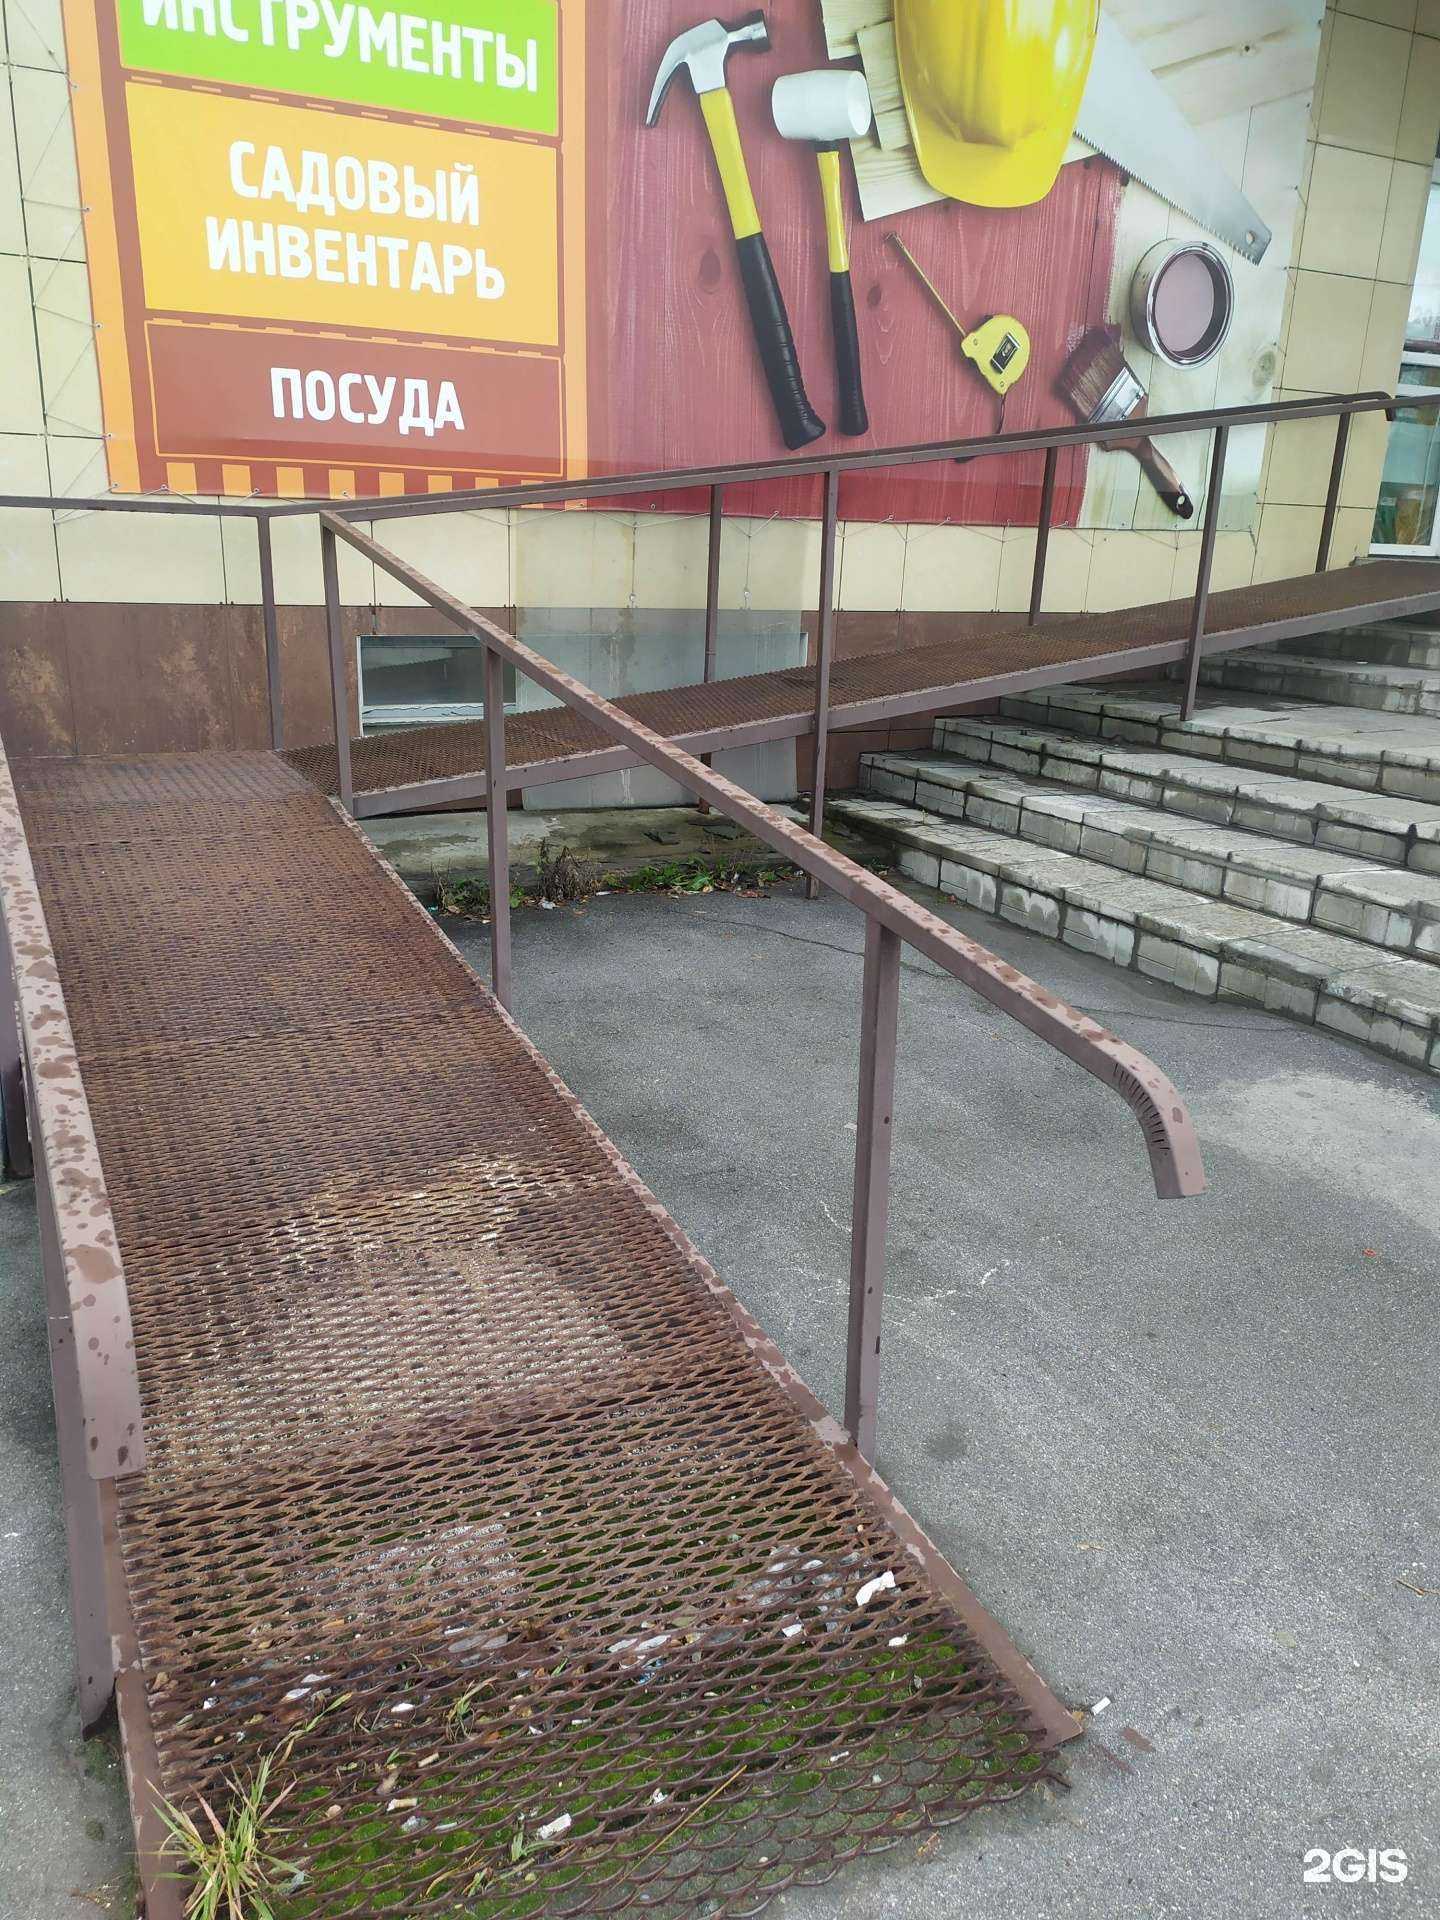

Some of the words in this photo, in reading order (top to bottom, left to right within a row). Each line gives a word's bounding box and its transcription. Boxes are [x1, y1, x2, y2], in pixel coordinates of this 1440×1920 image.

[229, 140, 480, 226] САДОВЫЙ
[205, 216, 506, 300] ИНВЕНТАРЬ
[270, 367, 465, 437] ПОСУДА
